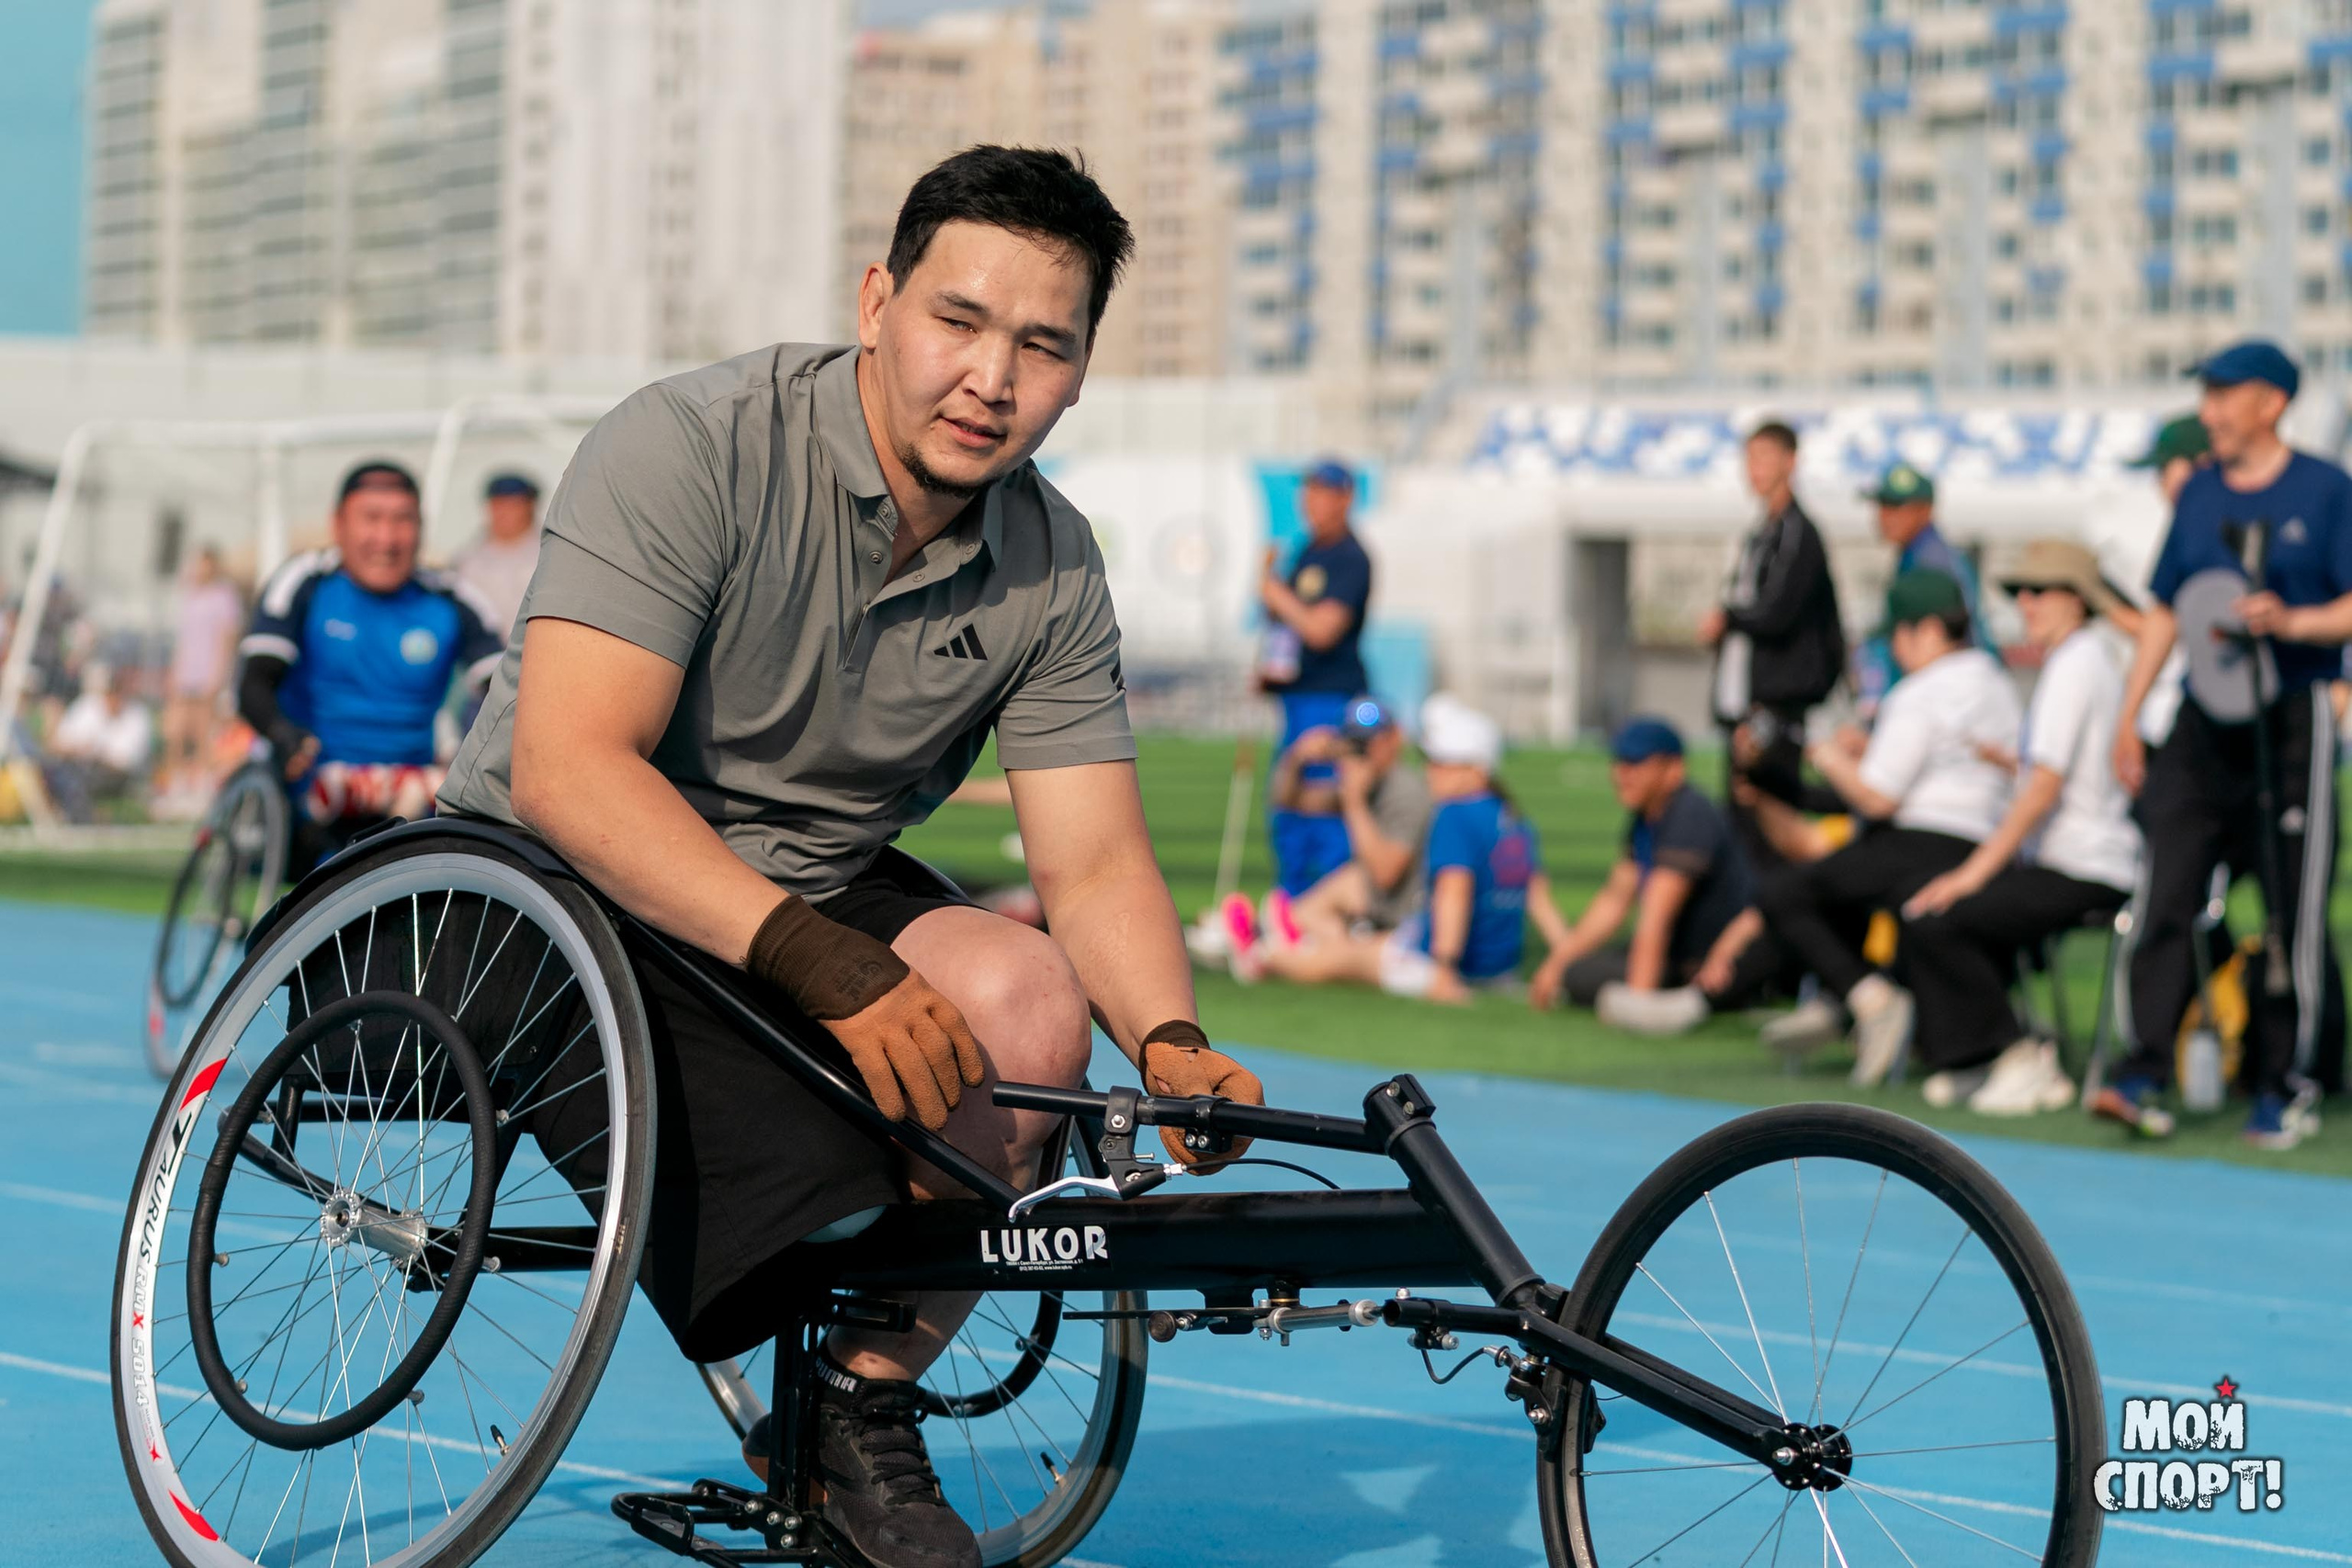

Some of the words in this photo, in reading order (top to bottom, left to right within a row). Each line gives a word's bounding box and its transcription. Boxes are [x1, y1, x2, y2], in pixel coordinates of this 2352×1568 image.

[140, 1111, 192, 1264] TAURUS
[980, 1225, 1109, 1263] LUKOR
[132, 1265, 148, 1329] RMX
[131, 1337, 150, 1406] 5014
